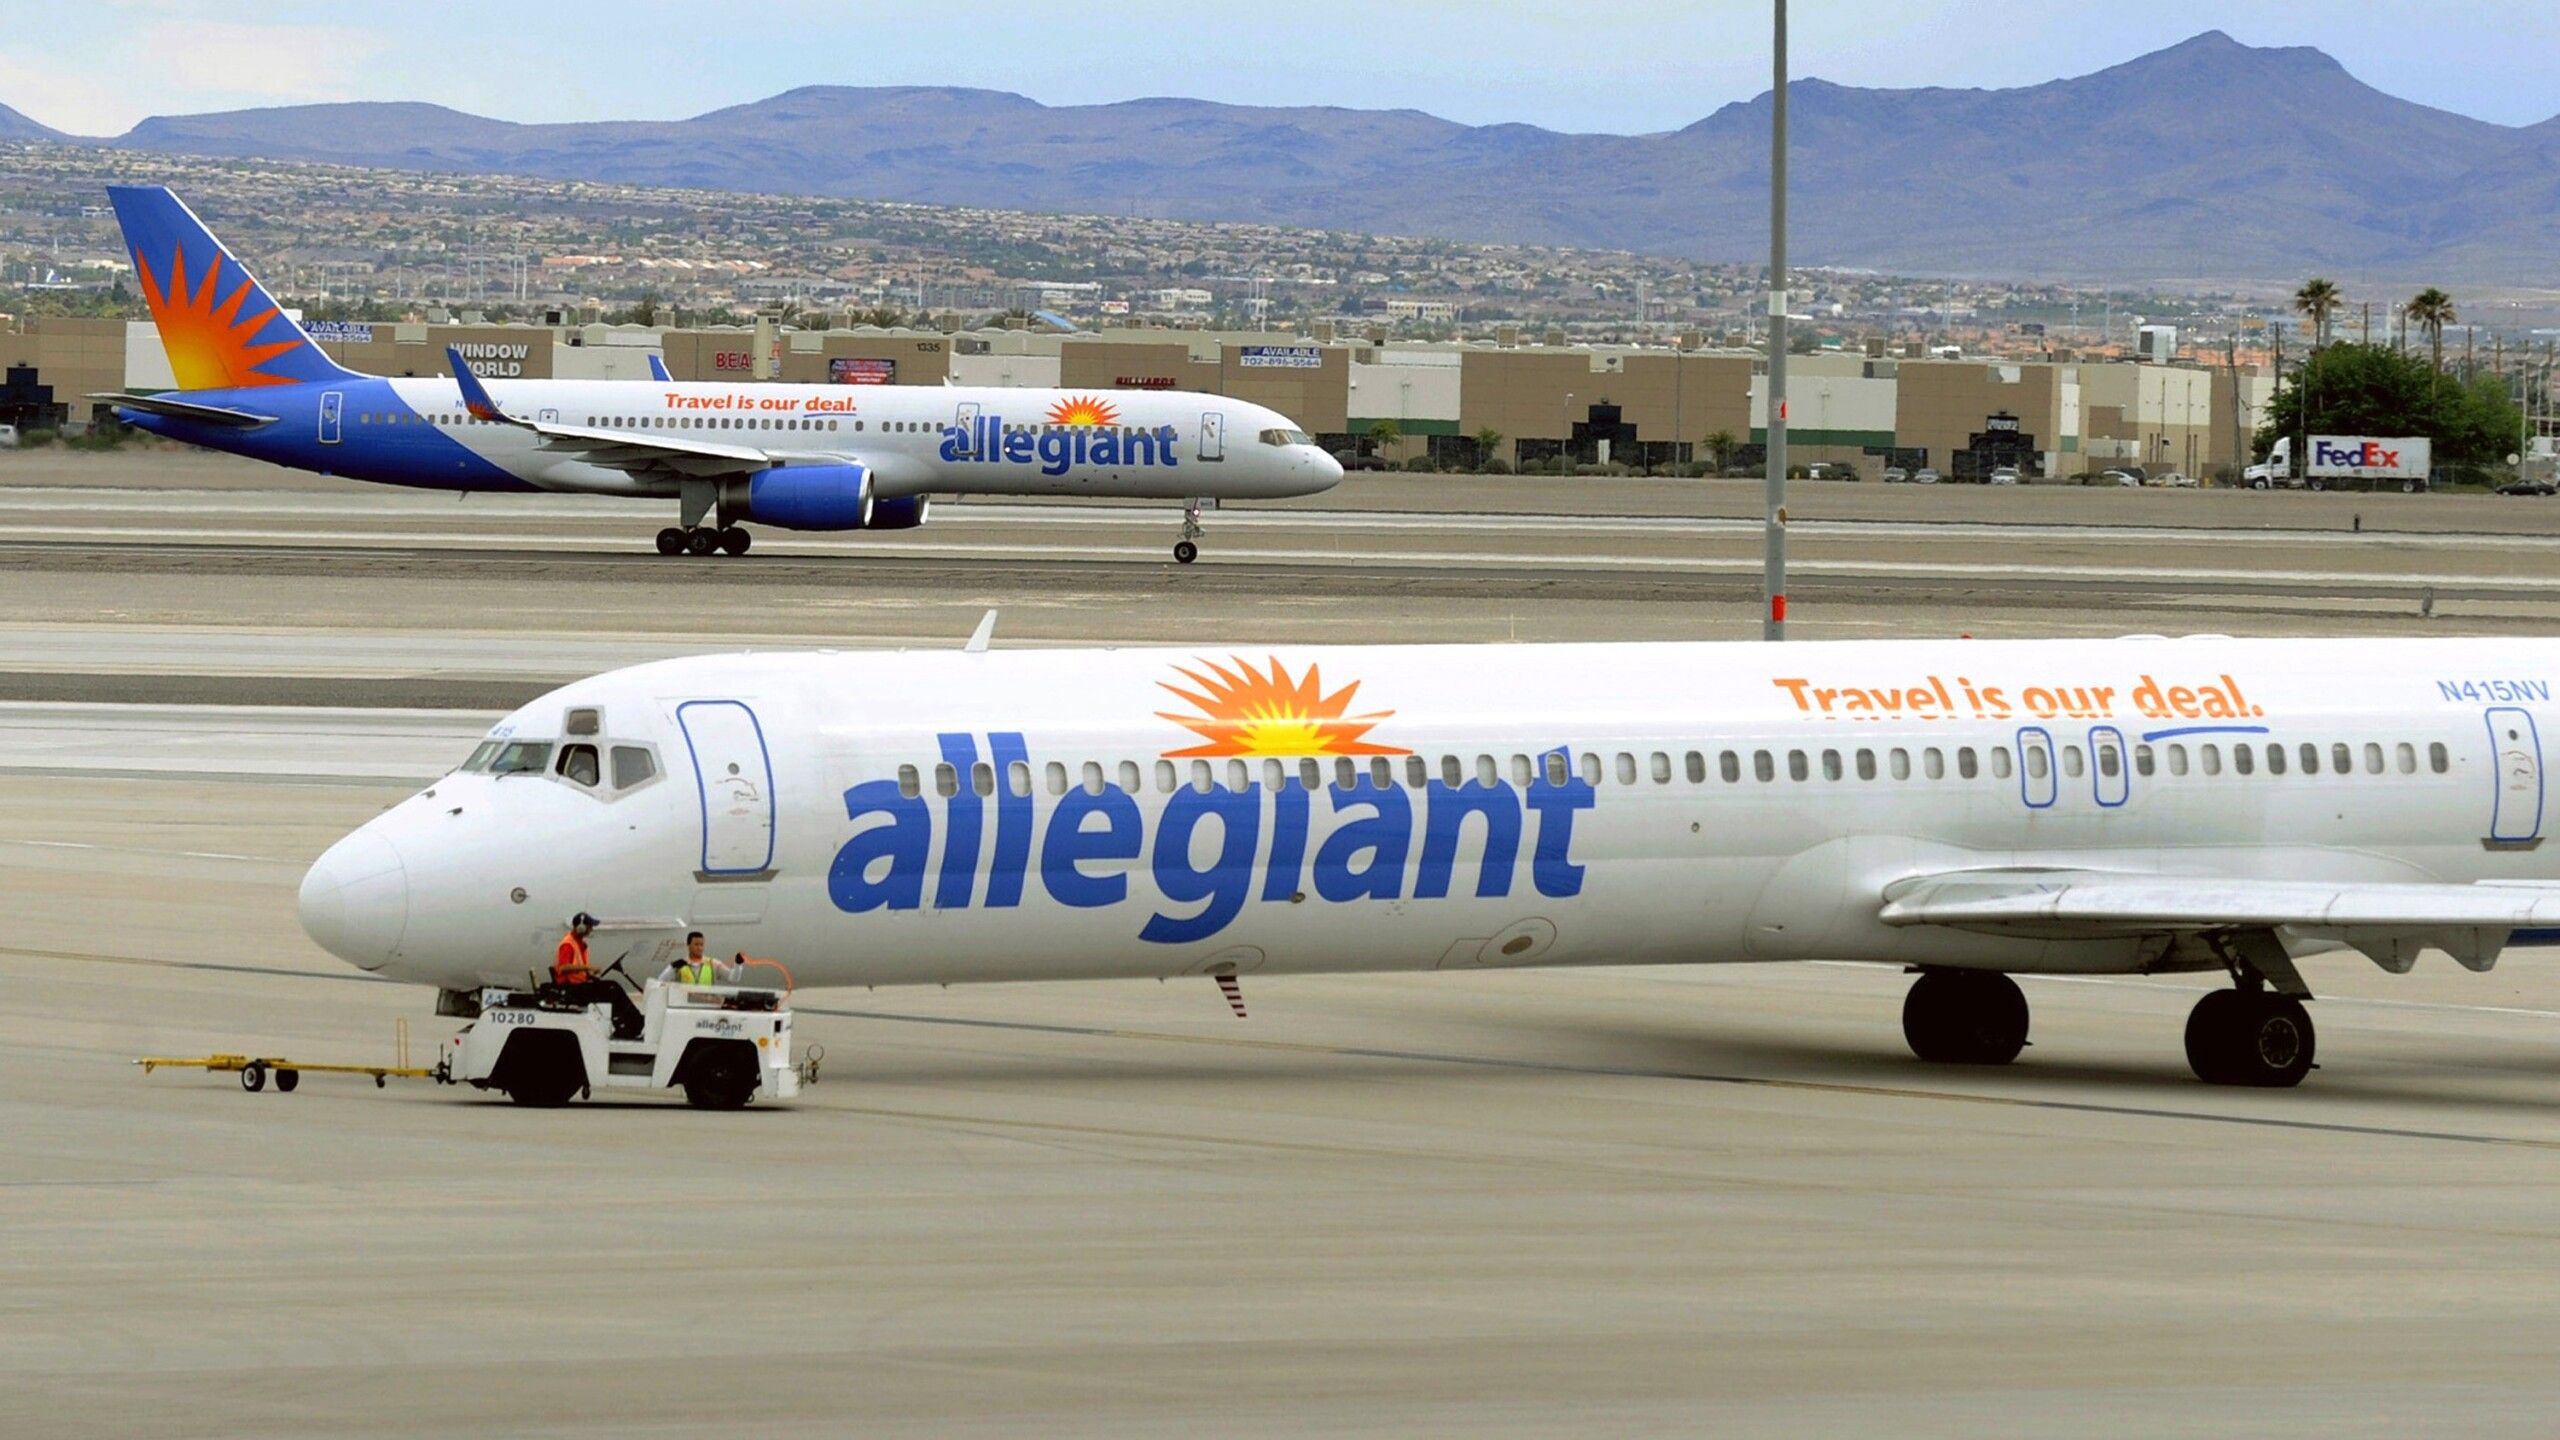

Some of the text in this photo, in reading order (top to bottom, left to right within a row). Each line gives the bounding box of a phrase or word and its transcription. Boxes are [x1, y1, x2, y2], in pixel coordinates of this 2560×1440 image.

[917, 343, 941, 352] 1335
[1262, 347, 1320, 356] AVAILABLE
[468, 361, 521, 376] ORLD
[664, 393, 858, 412] Travel is our deal.
[939, 415, 1179, 476] allegiant
[2315, 440, 2400, 468] FedEx
[1773, 674, 2266, 721] Travel is our deal.
[2437, 680, 2551, 702] N415NV
[828, 732, 1597, 944] allegiant
[491, 1012, 536, 1025] 10280
[695, 1020, 743, 1032] allegiant
